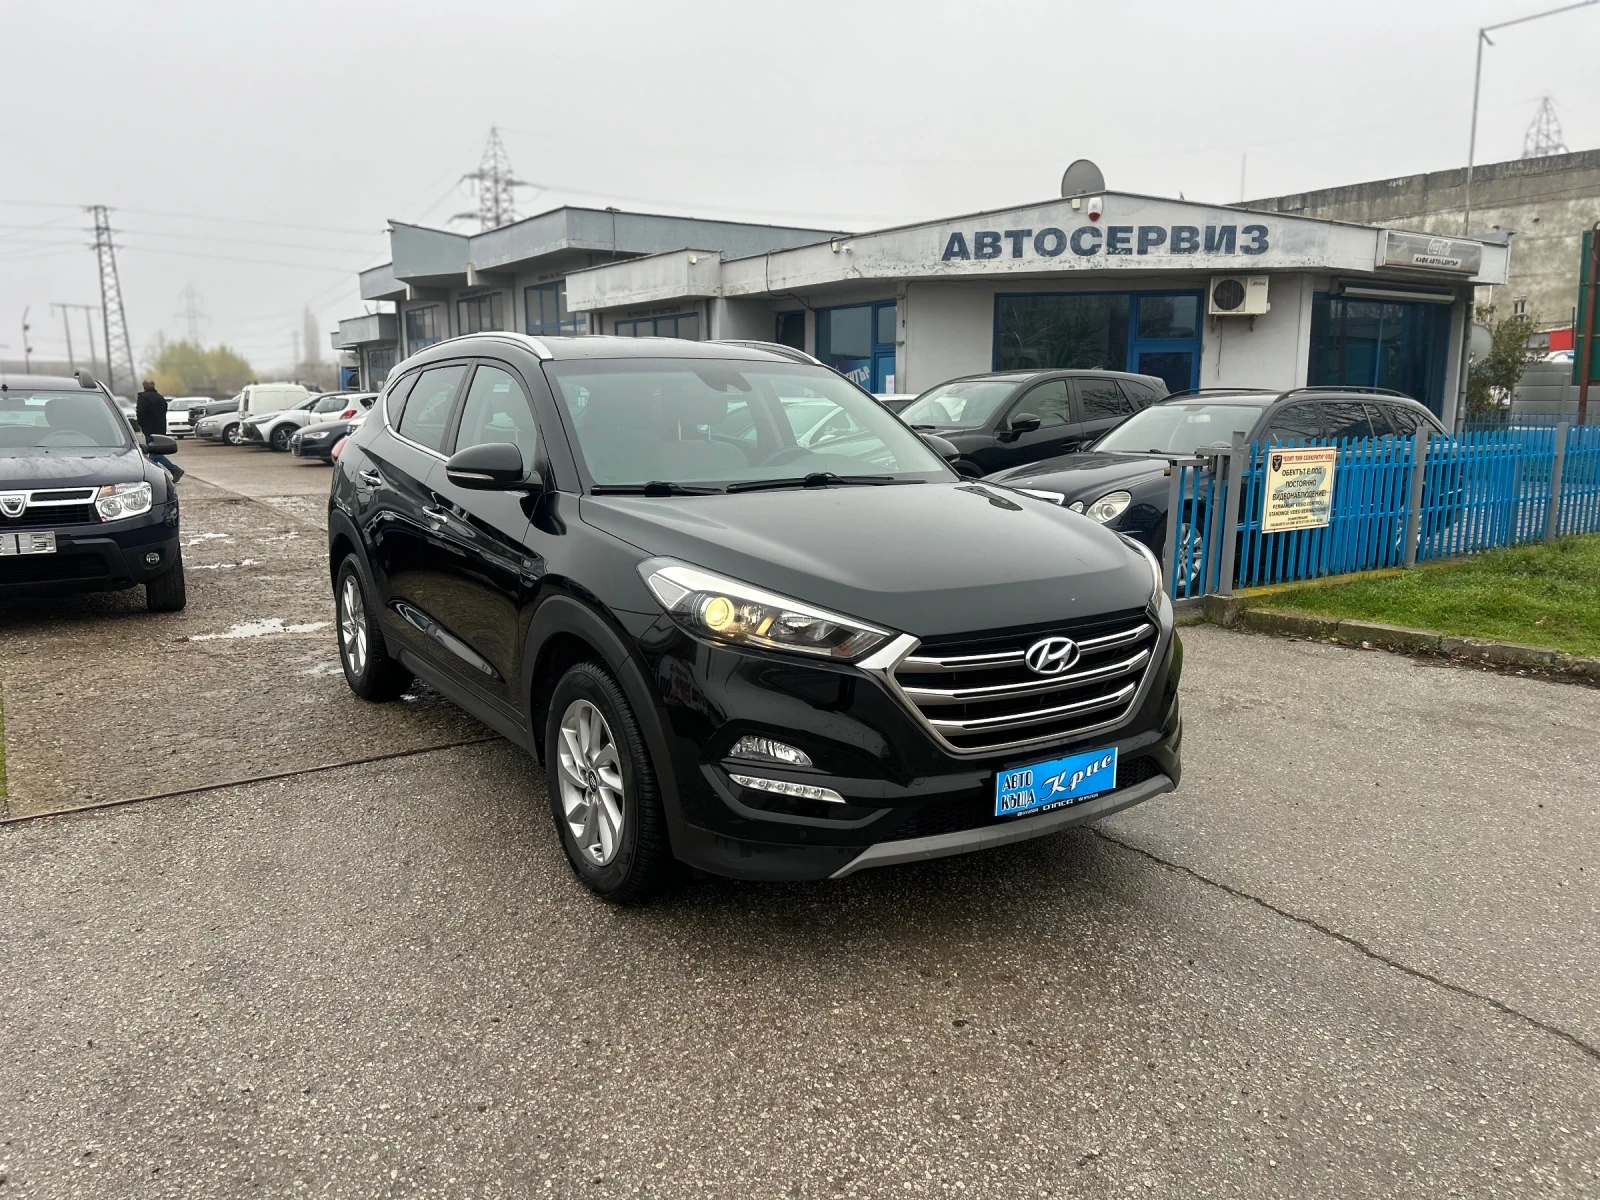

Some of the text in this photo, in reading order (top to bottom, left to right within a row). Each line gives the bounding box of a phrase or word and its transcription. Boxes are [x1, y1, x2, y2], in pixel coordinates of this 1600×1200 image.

[941, 225, 1269, 261] АВТОСЕРВИЗ
[1415, 256, 1429, 264] КАФЕ
[1282, 468, 1306, 477] ОБЕКТЪТ
[1311, 467, 1322, 475] ПОД
[1285, 480, 1317, 488] ПОСТОЯННО
[1272, 490, 1327, 501] ВИДЕОНАБЛЮДЕНИЕ!
[1002, 770, 1034, 792] АВТО
[1041, 754, 1114, 801] Крис
[1001, 789, 1036, 811] КЪЩА
